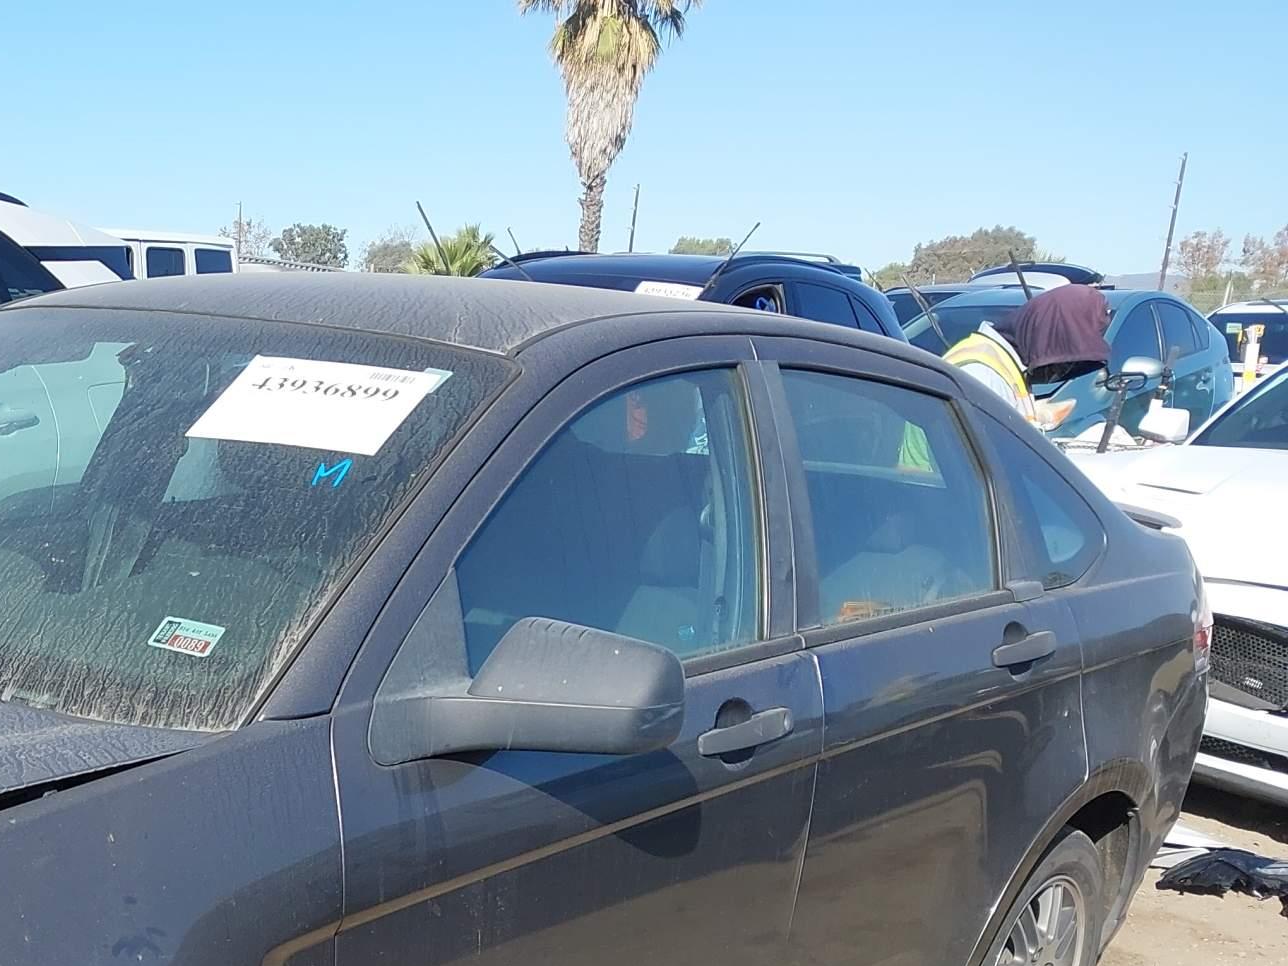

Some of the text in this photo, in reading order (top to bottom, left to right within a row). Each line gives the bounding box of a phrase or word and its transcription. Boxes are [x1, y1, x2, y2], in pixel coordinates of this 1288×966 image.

[252, 376, 400, 402] 43936899
[311, 458, 354, 489] M
[173, 636, 206, 652] 0089
